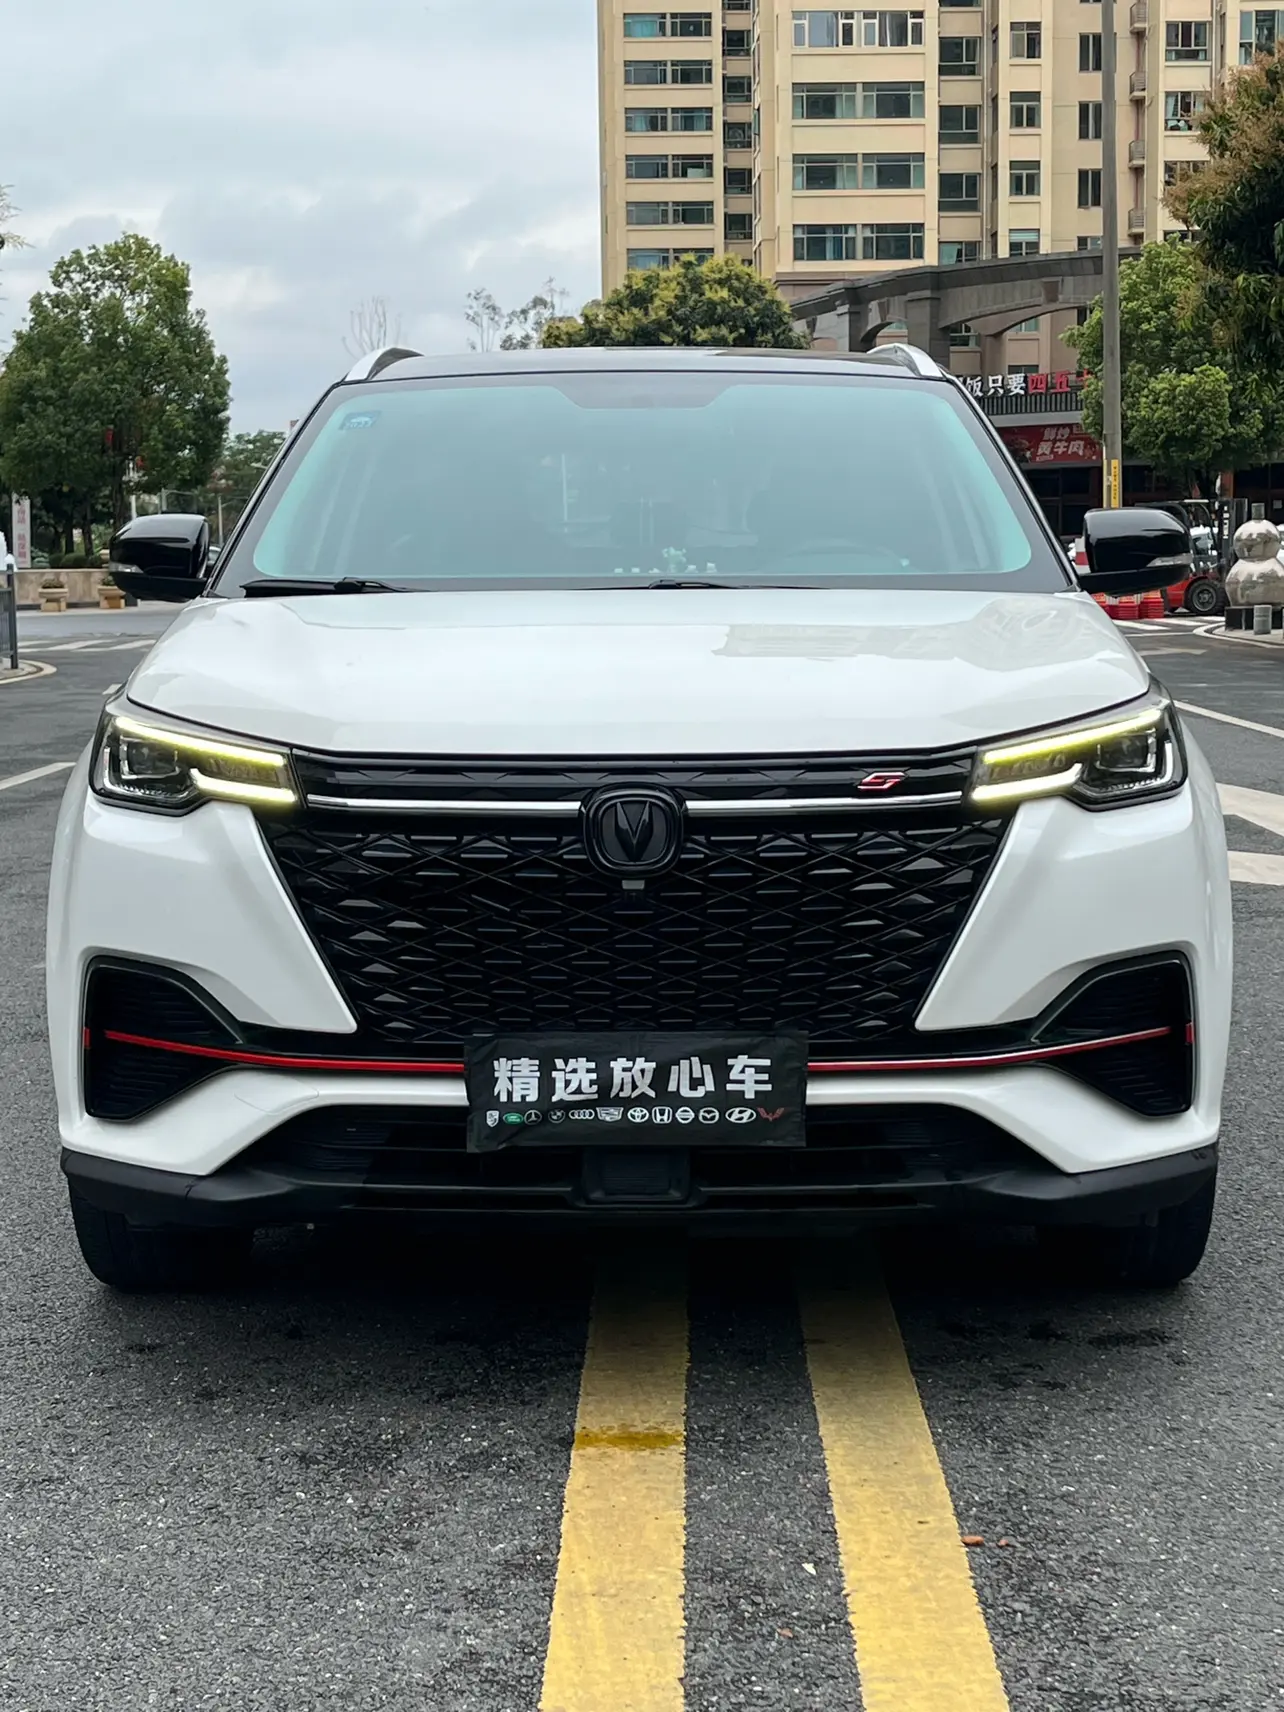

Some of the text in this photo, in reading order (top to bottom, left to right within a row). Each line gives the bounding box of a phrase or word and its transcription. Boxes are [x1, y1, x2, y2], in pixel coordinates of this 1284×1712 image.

[493, 1054, 773, 1103] 精选放心车
